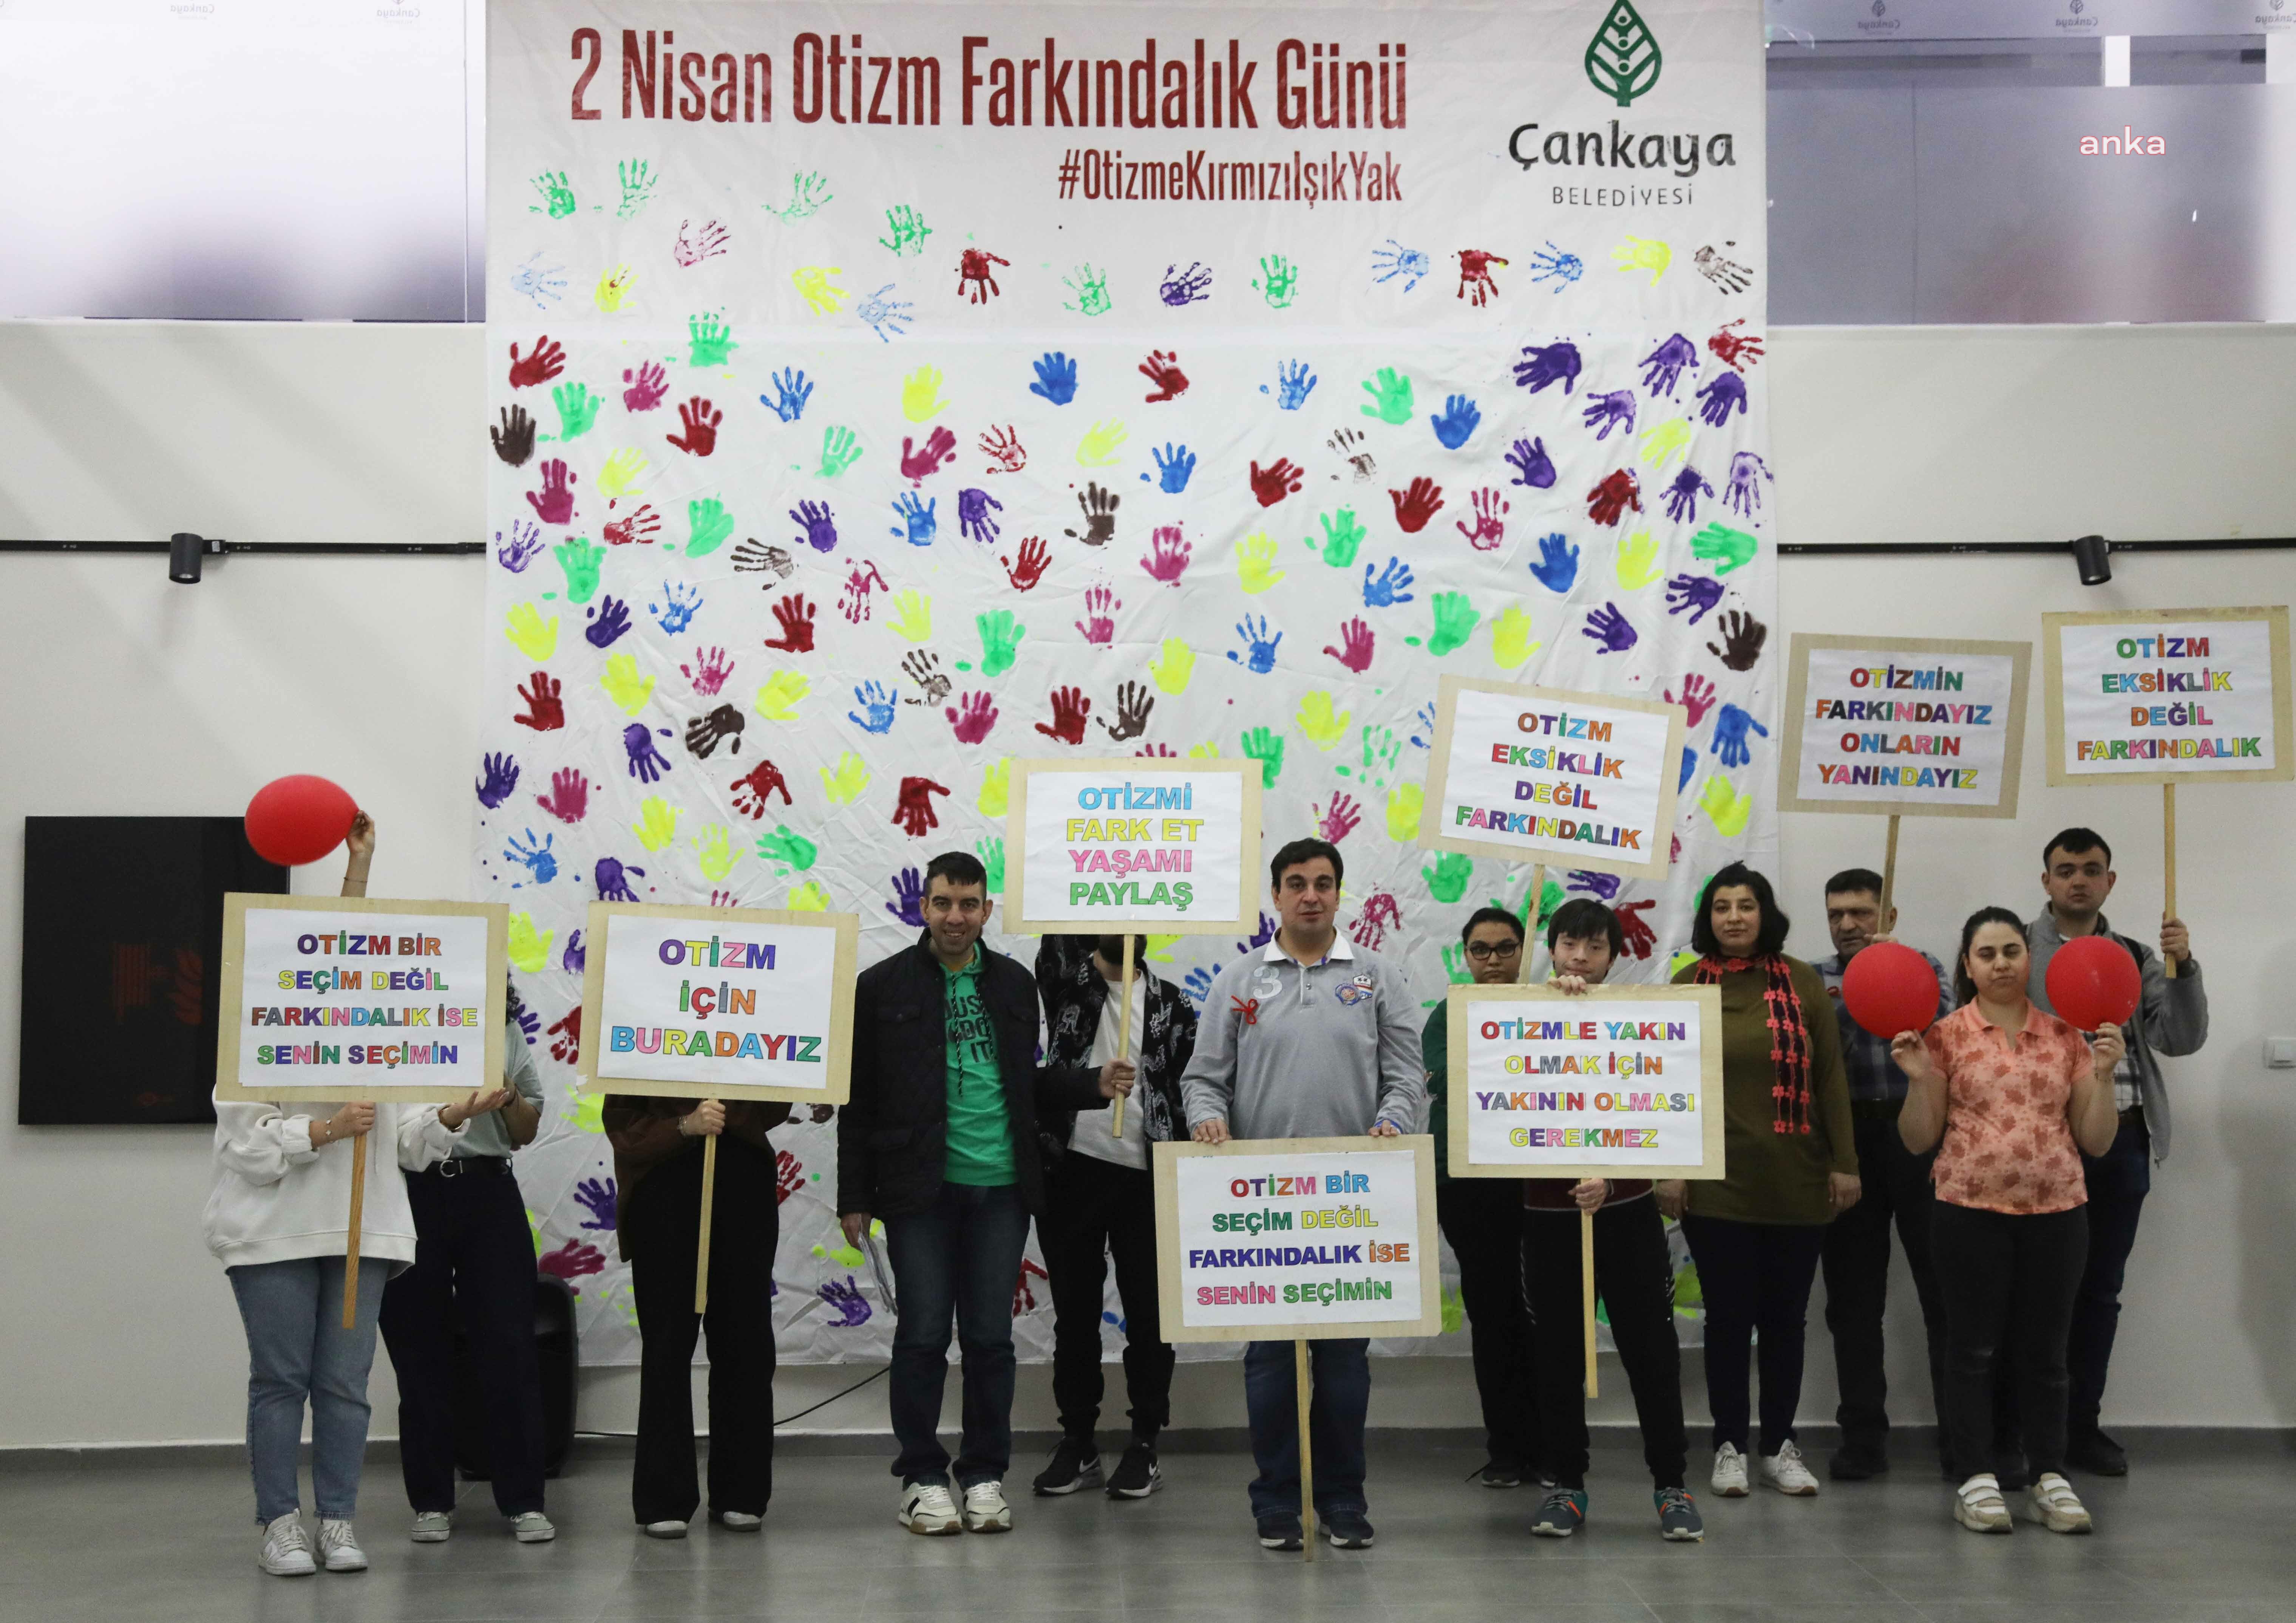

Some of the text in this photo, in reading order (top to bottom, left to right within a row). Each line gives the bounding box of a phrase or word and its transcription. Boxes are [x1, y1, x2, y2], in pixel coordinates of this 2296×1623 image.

[571, 28, 1406, 129] 2 Nisan Otizm Farkındalık Günü
[1509, 119, 1736, 178] Çankaya
[1553, 184, 1692, 207] BELEDİYESİ
[2117, 634, 2209, 658] OTİZM
[1851, 665, 1963, 691] OTİZMİN
[2102, 668, 2233, 692] EKSİKLİK
[1816, 699, 1992, 725] FARKINDAYIZ
[2131, 702, 2213, 726] DEĞİL
[1518, 713, 1612, 742] OTİZM
[1841, 733, 1961, 756] ONLARIN
[2078, 737, 2261, 760] FARKINDALIK
[1492, 743, 1624, 779] EKSİKLİK
[1818, 764, 1978, 789] YANINDAYIZ
[1078, 782, 1192, 810] OTİZMİ
[1515, 781, 1598, 810] DEĞİL
[1067, 819, 1204, 841] FARK ET
[1456, 805, 1642, 849] FARKINDALIK
[1068, 850, 1192, 878] YAŞAMI
[1070, 882, 1193, 911] PAYLAŞ
[298, 931, 442, 956] OTİZM BİR
[659, 935, 776, 969] OTİZM
[278, 966, 448, 994] SEÇİM DEĞİL
[1253, 965, 1282, 999] 3
[680, 980, 756, 1019] İÇİN
[252, 1004, 477, 1026] FARKINDALIK İSE
[1481, 1017, 1685, 1040] OTİZMLE YAKIN
[257, 1041, 457, 1068] SENİN SEÇİMİN
[610, 1026, 821, 1062] BURADAYIZ
[1505, 1052, 1662, 1079] OLMAK İÇİN
[1476, 1092, 1694, 1111] YAKININ OLMASI
[1510, 1128, 1658, 1148] GEREKMEZ
[1231, 1170, 1370, 1198] OTİZM BİR
[1213, 1205, 1378, 1236] SEÇİM DEĞİL
[1189, 1240, 1410, 1268] FARKINDALIK İSE
[1197, 1277, 1392, 1306] SENİN SEÇİMİN
